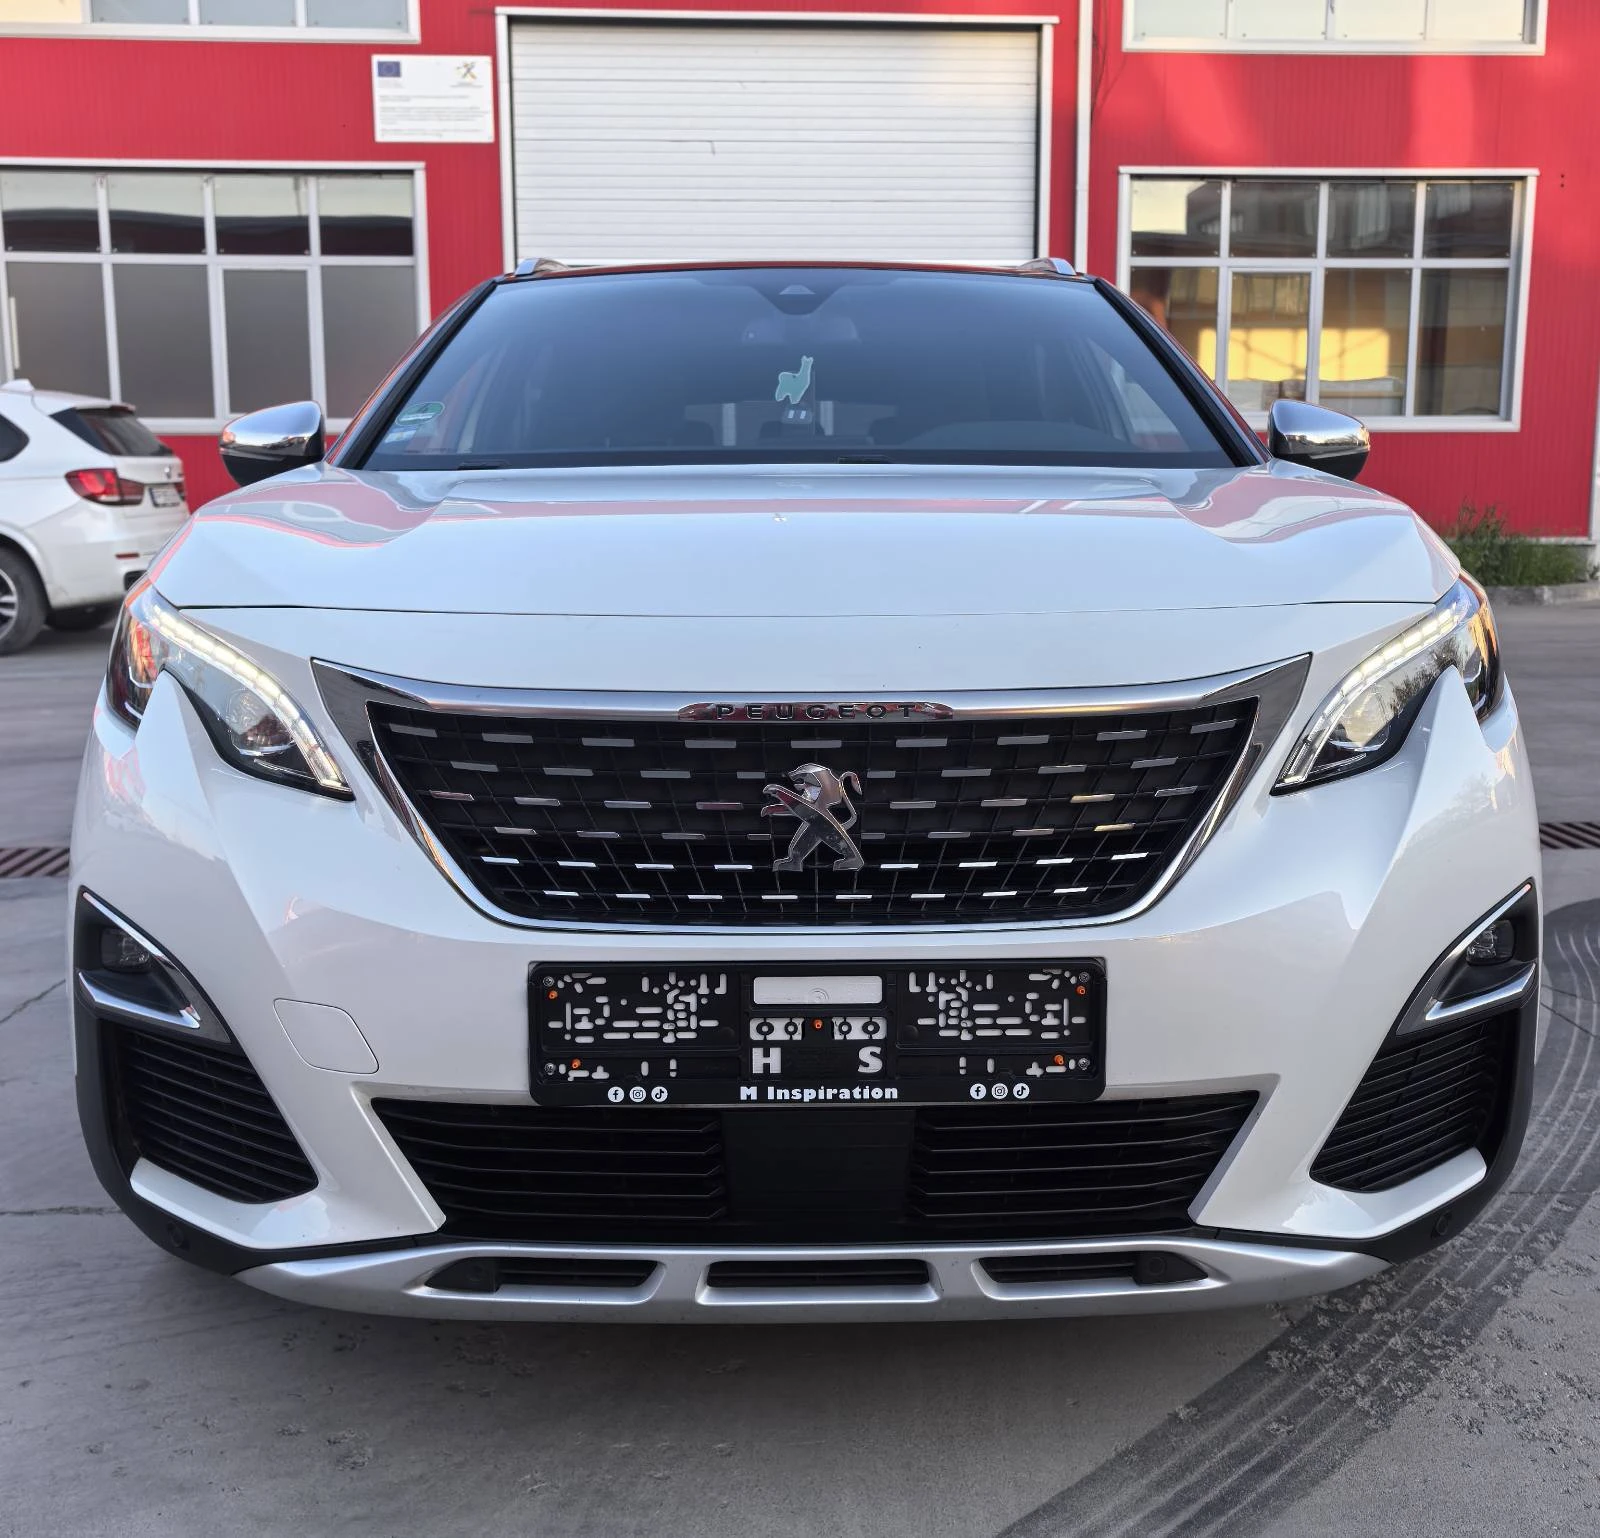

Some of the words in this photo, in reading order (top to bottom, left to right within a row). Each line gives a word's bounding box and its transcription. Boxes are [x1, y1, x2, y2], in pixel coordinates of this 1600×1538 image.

[715, 703, 918, 720] PEUGEOT
[752, 1047, 782, 1073] H
[857, 1046, 883, 1073] S
[740, 1086, 758, 1101] M
[767, 1085, 898, 1101] Inspiration
